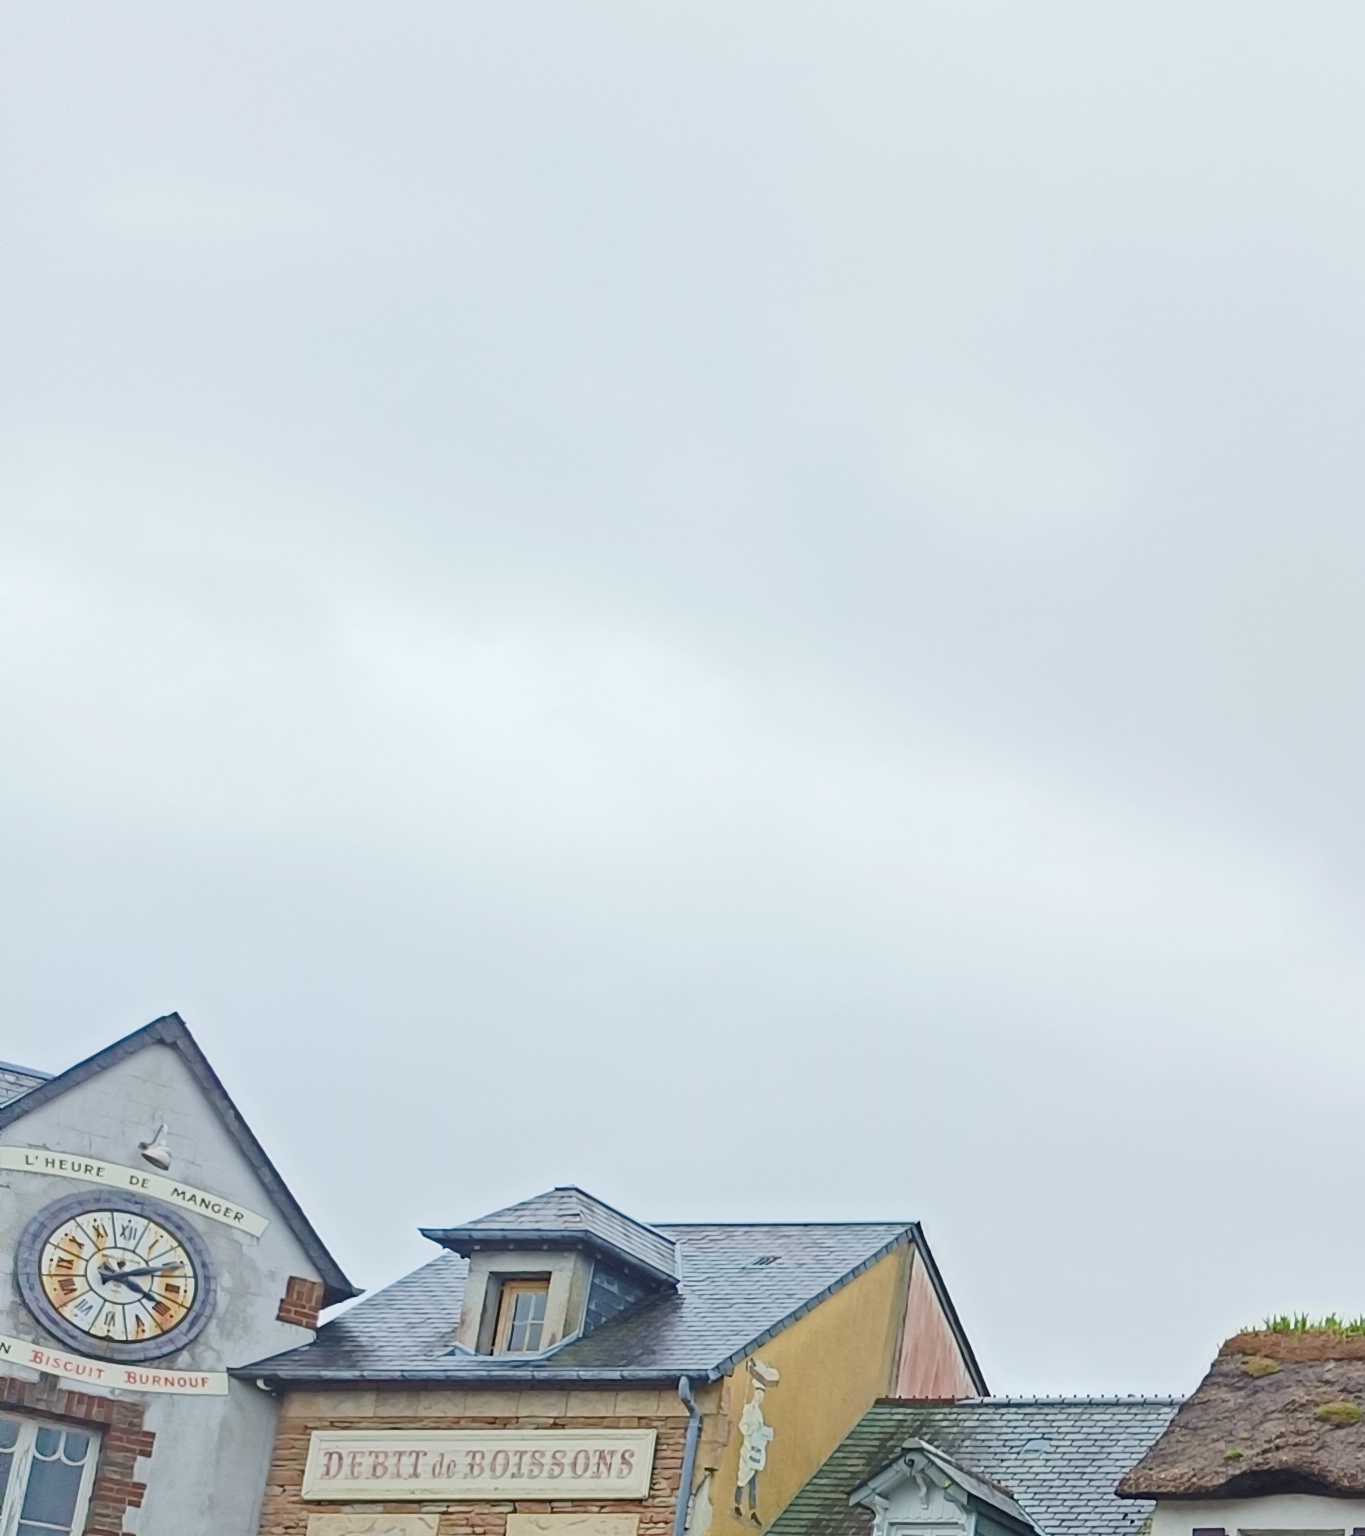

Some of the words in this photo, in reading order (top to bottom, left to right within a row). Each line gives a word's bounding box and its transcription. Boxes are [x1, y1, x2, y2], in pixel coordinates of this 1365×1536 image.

[25, 1154, 106, 1178] L'HEURE
[129, 1174, 150, 1189] DE
[171, 1187, 245, 1223] MANGER
[29, 1349, 106, 1380] BISCUIT
[124, 1370, 210, 1389] BURNOUF
[320, 1450, 428, 1480] DEBIT
[463, 1449, 636, 1480] BOISSONS
